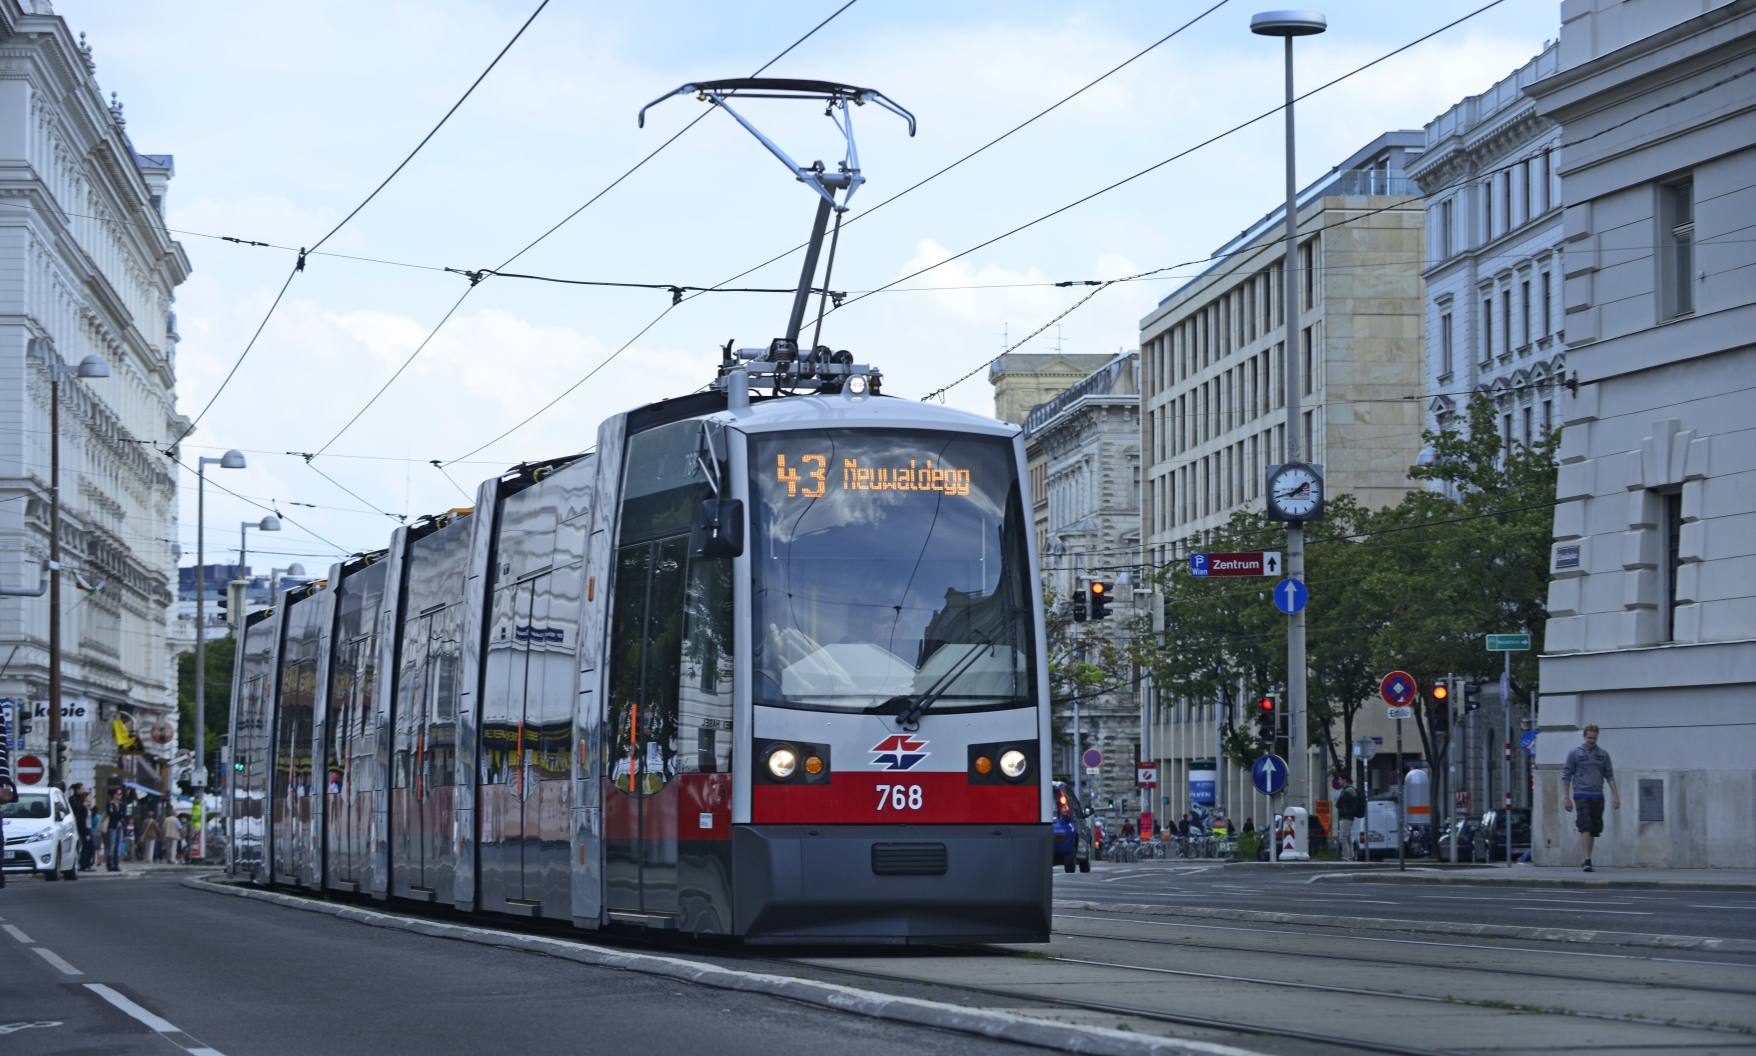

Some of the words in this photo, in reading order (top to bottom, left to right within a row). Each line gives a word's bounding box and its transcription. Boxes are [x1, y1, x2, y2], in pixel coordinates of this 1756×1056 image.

[776, 453, 826, 498] 43
[842, 457, 970, 497] Neuwaldegg
[1212, 559, 1259, 570] Zentrum
[875, 784, 923, 811] 768
